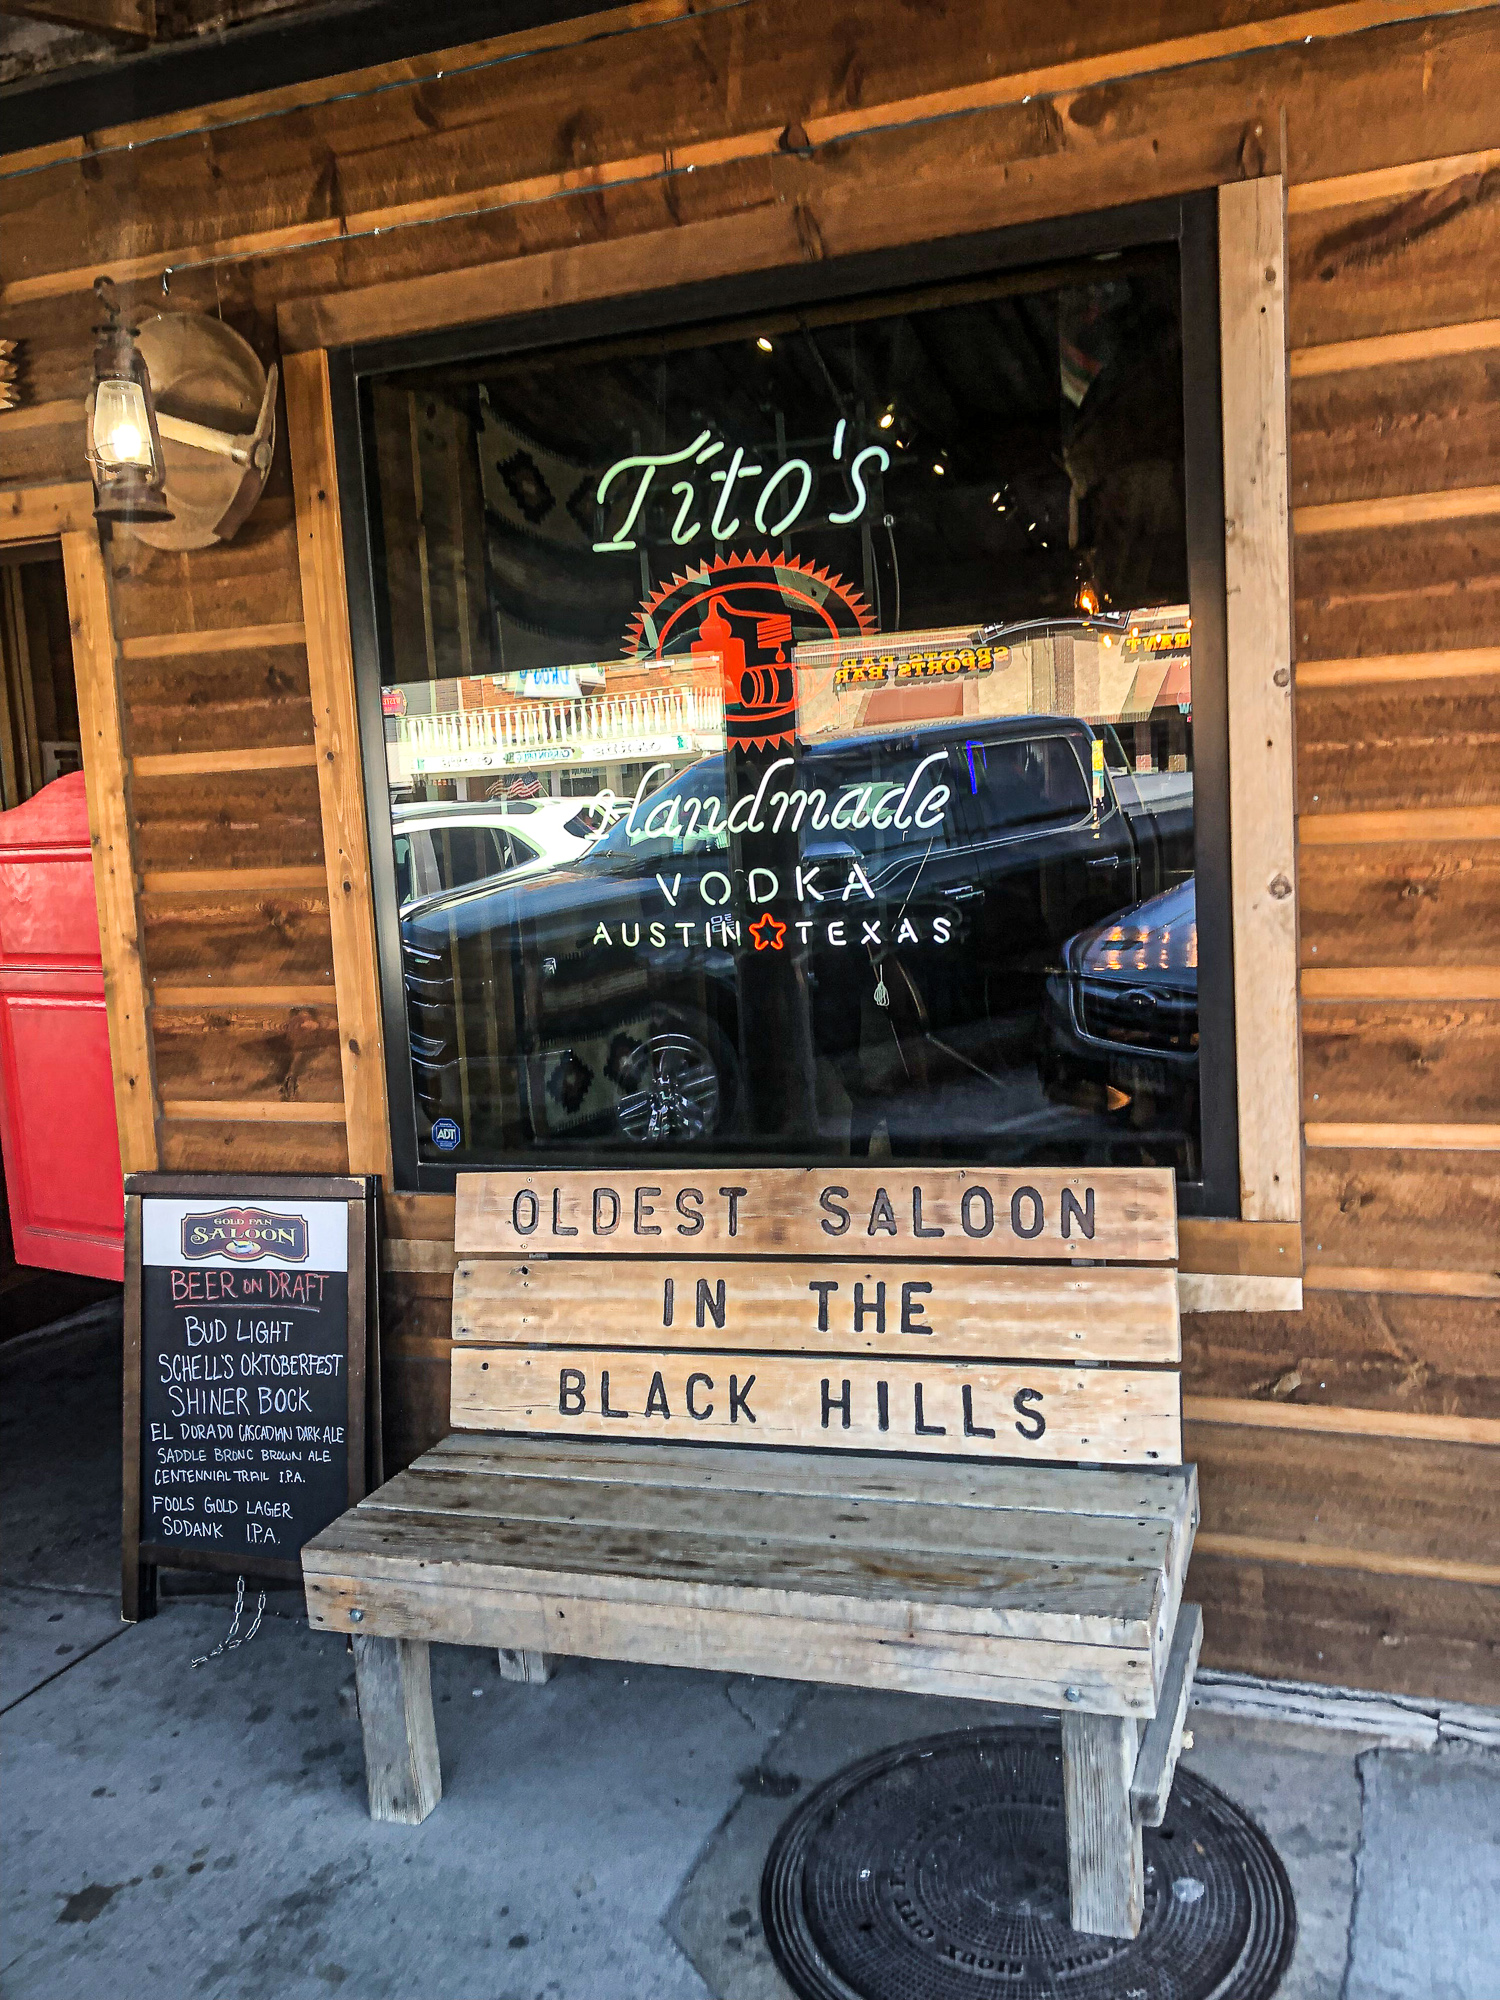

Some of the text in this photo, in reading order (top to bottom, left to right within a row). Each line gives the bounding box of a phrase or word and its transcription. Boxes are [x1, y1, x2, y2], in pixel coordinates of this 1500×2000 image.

[592, 418, 890, 552] Tito's
[584, 751, 951, 840] Handmade
[656, 864, 875, 906] VODKA
[592, 917, 952, 949] AUSTIN TEXAS
[437, 1129, 455, 1140] ADT
[249, 1218, 272, 1226] PAN
[512, 1186, 1096, 1240] OLDEST SALOON
[190, 1226, 297, 1246] SALOON
[170, 1270, 239, 1301] BEER
[267, 1270, 330, 1303] DRAFT
[662, 1277, 934, 1335] IN THE
[185, 1315, 294, 1347] BUD LIGHT
[158, 1352, 344, 1383] SCHELL'S OKTOBERFEST
[168, 1385, 312, 1417] SHINER BOCK
[559, 1367, 1047, 1441] BLACK HILLS
[150, 1423, 174, 1442] EL
[180, 1423, 234, 1440] DORADO
[296, 1425, 321, 1443] DARK
[322, 1426, 345, 1444] ALE
[157, 1448, 332, 1464] SADDLE BRONC BROWN ALE
[154, 1469, 306, 1486] CENTENNIAL TRAIL I.P.A.
[152, 1496, 293, 1519] FOOLS GOLD LAGER
[162, 1515, 224, 1539] SODANK
